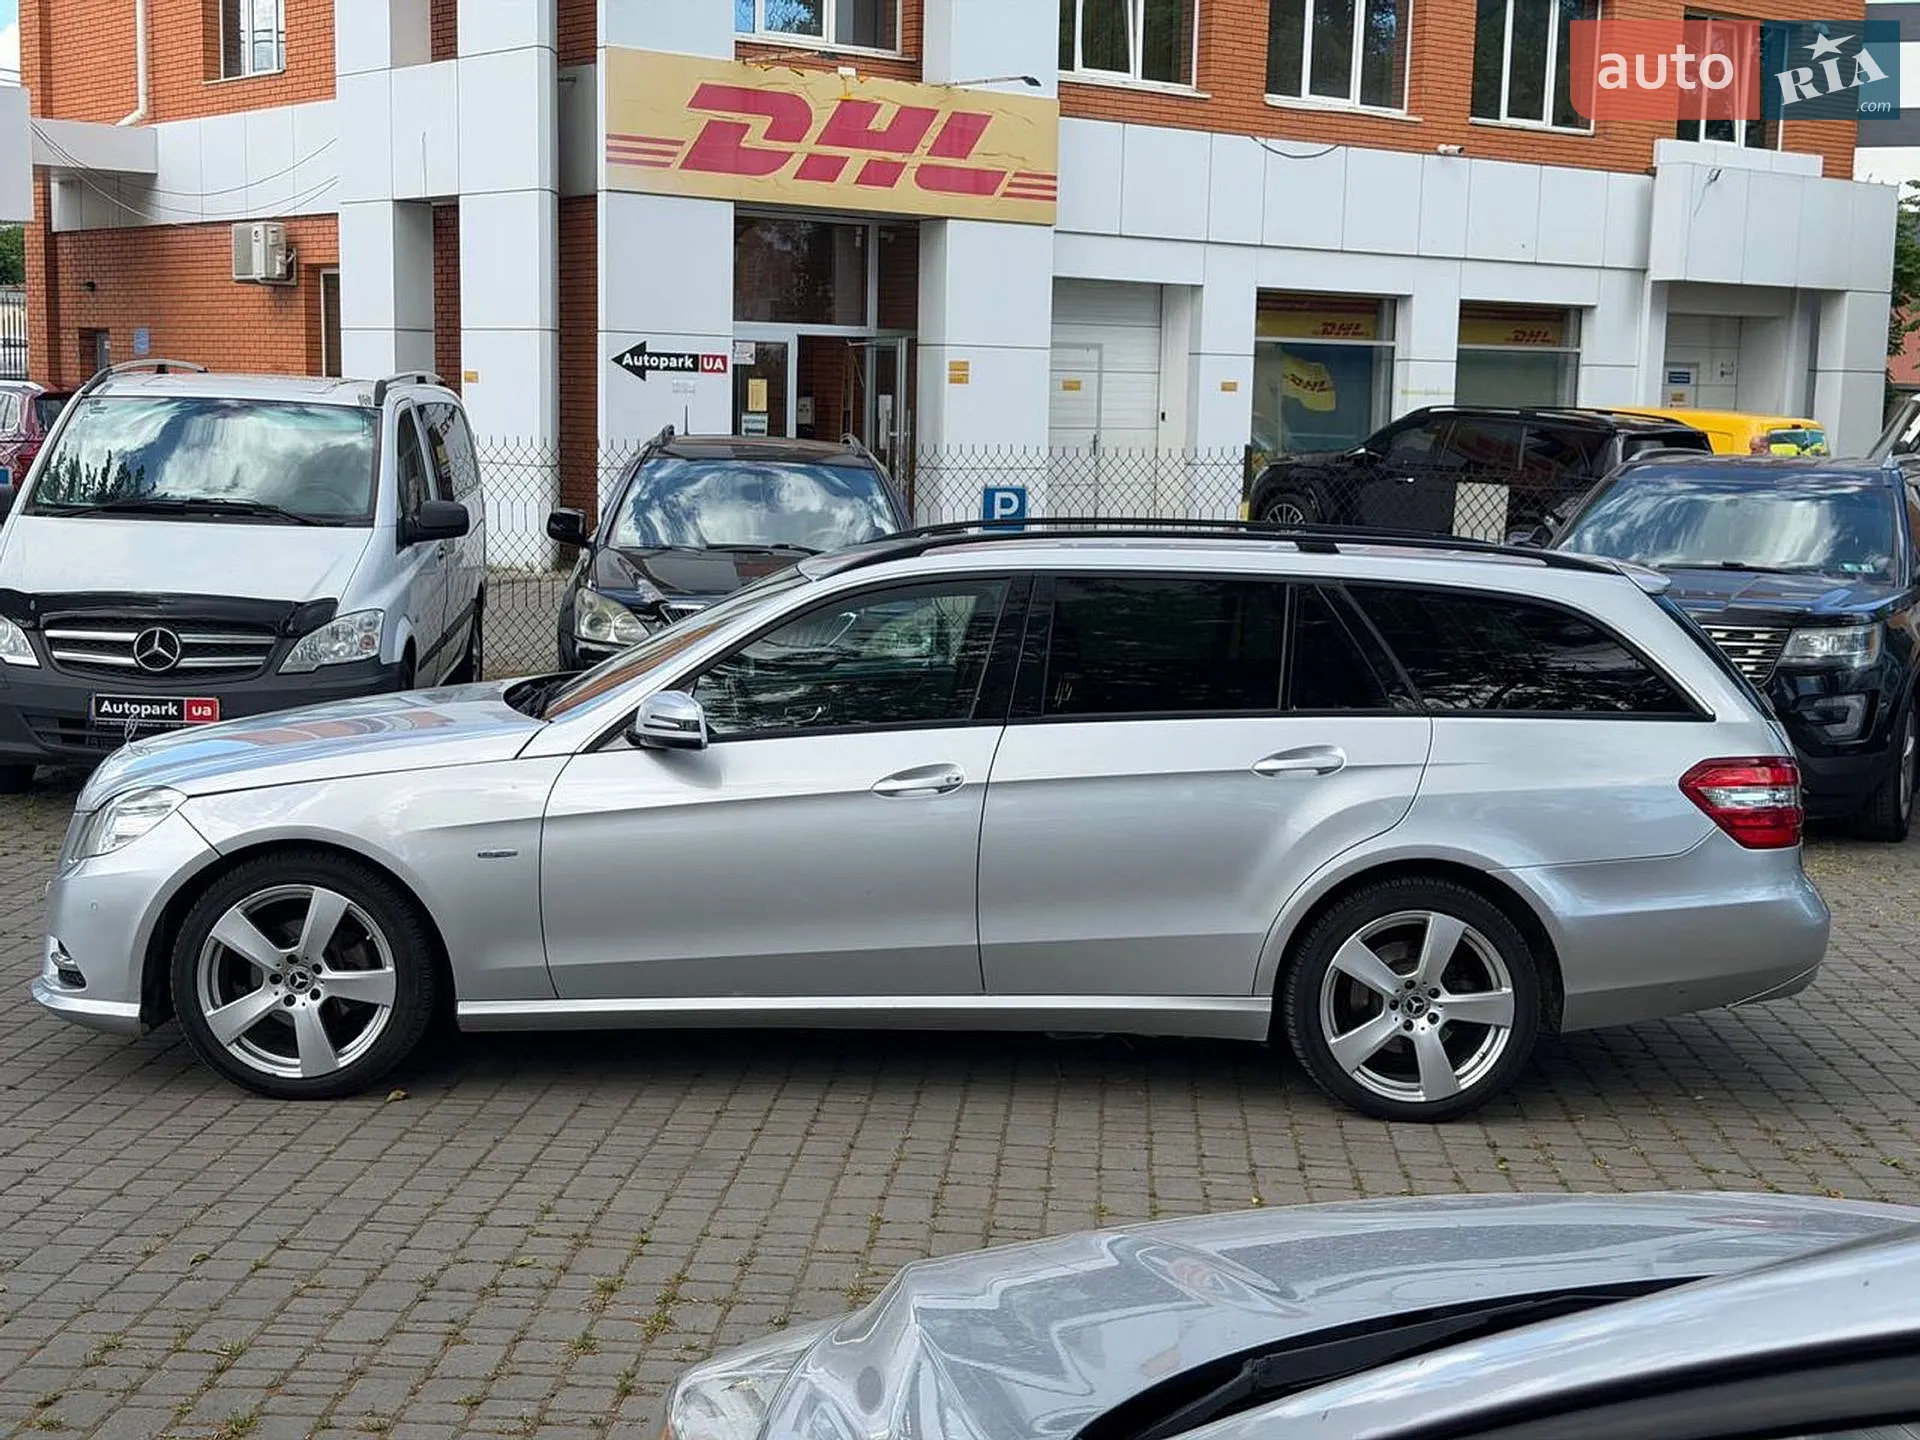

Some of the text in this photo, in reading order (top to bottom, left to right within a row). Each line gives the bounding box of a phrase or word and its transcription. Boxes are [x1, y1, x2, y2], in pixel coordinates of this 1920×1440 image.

[678, 82, 1008, 196] DHL
[1319, 322, 1365, 337] DHL
[1511, 328, 1554, 344] DHL
[622, 353, 725, 371] Autopark UA
[1289, 372, 1329, 393] DHL
[994, 491, 1019, 520] P
[100, 700, 213, 718] Autopark ua
